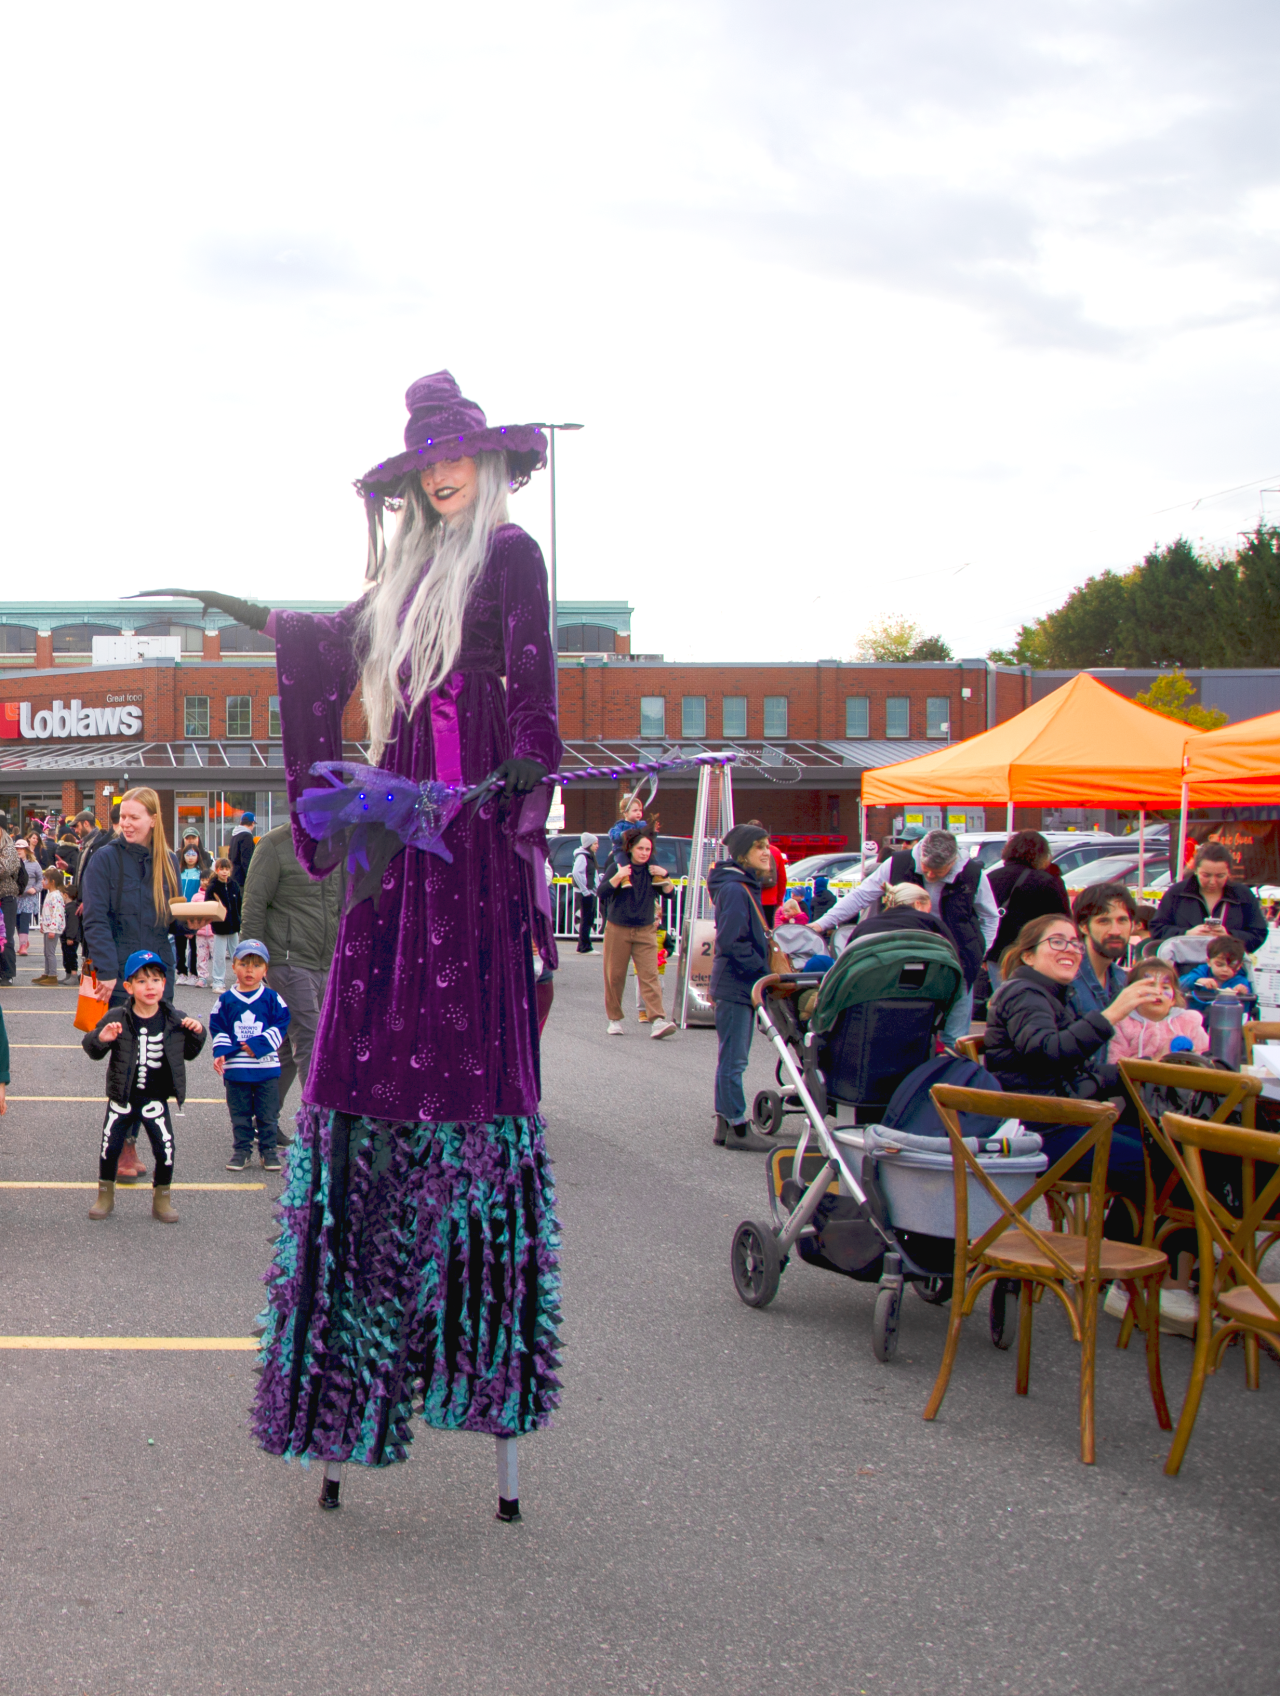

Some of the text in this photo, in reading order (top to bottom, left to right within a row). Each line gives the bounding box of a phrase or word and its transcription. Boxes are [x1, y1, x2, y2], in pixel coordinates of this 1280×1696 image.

[106, 693, 143, 703] Great food
[20, 698, 143, 739] Loblaws
